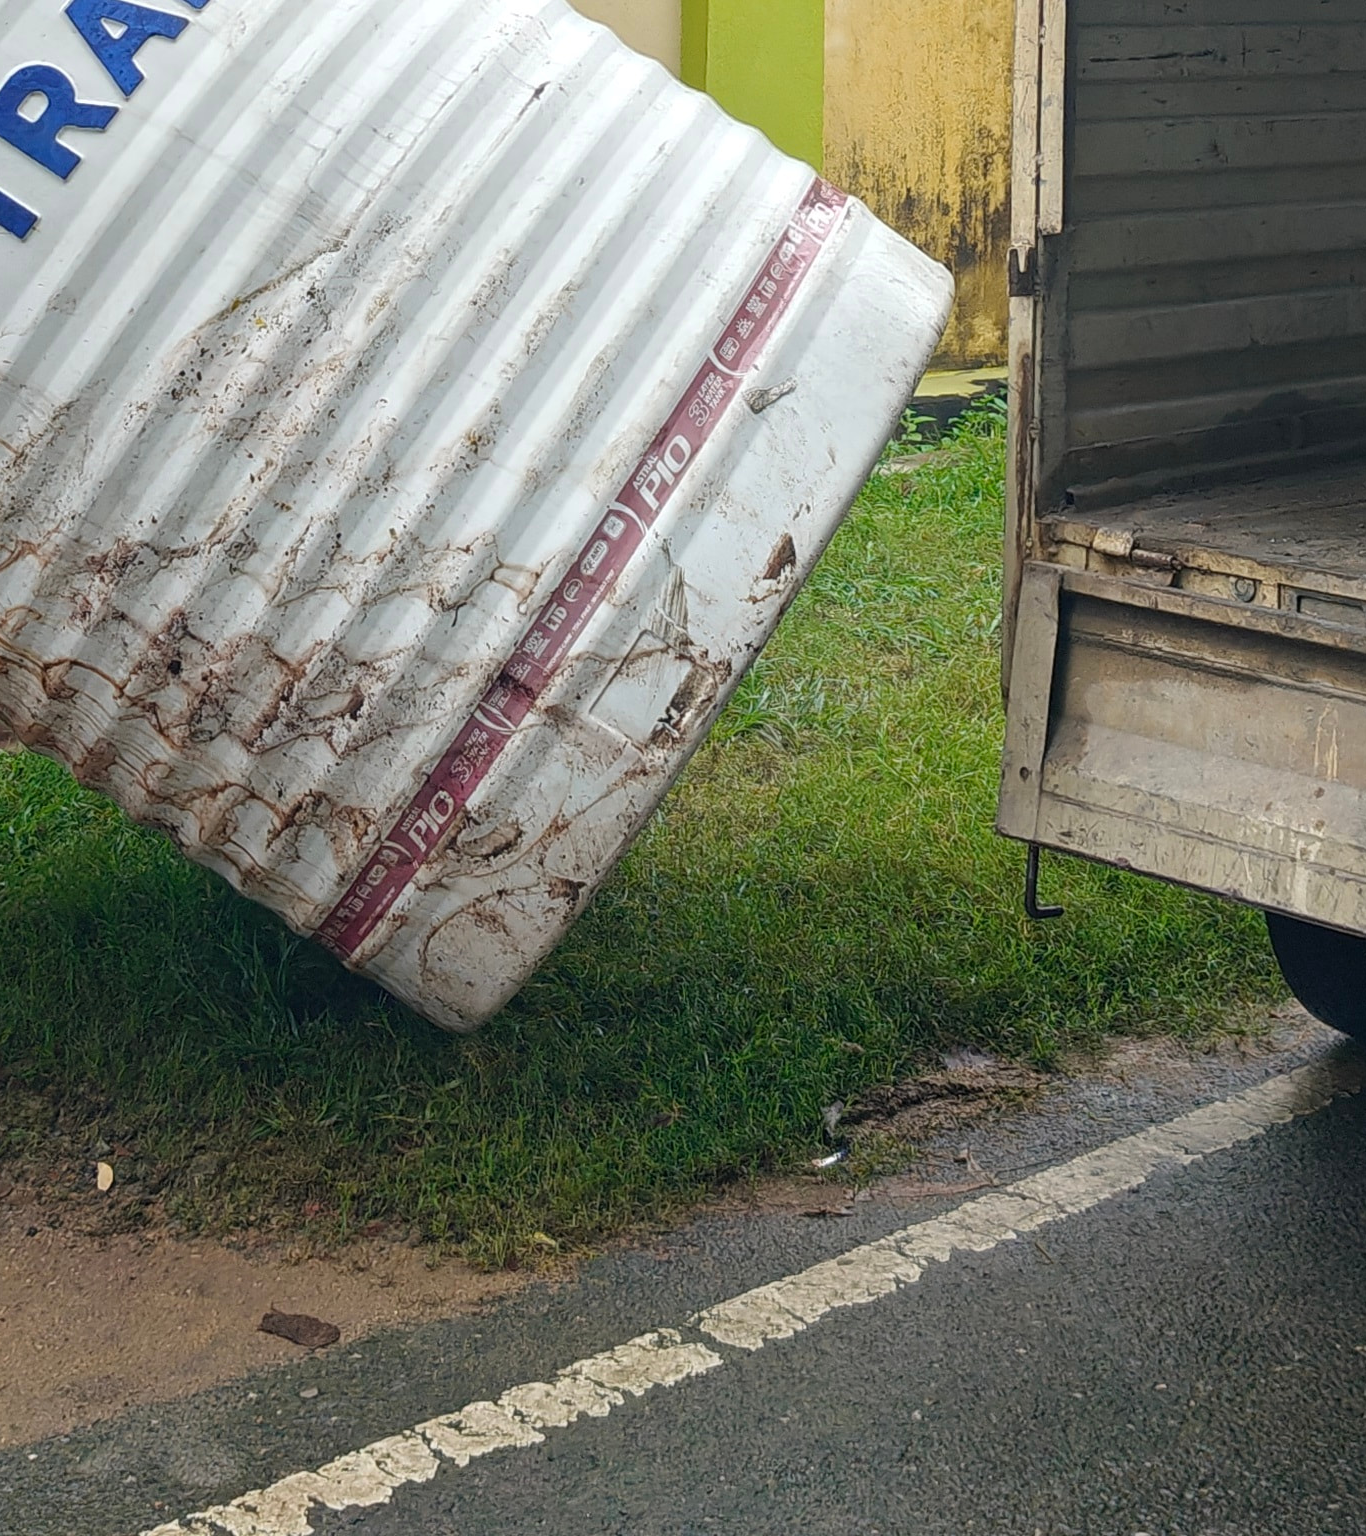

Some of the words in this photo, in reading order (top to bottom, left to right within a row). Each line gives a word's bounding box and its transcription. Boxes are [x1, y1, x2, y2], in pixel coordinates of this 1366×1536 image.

[804, 200, 836, 234] PIO
[696, 372, 716, 398] LAYER
[701, 374, 724, 404] WATER
[708, 386, 727, 409] TANK
[684, 397, 714, 428] 3
[630, 451, 659, 489] ASTRAL
[634, 431, 697, 510] PIO
[544, 604, 569, 632] LID
[521, 628, 543, 655] 100%
[404, 787, 460, 853] PIO
